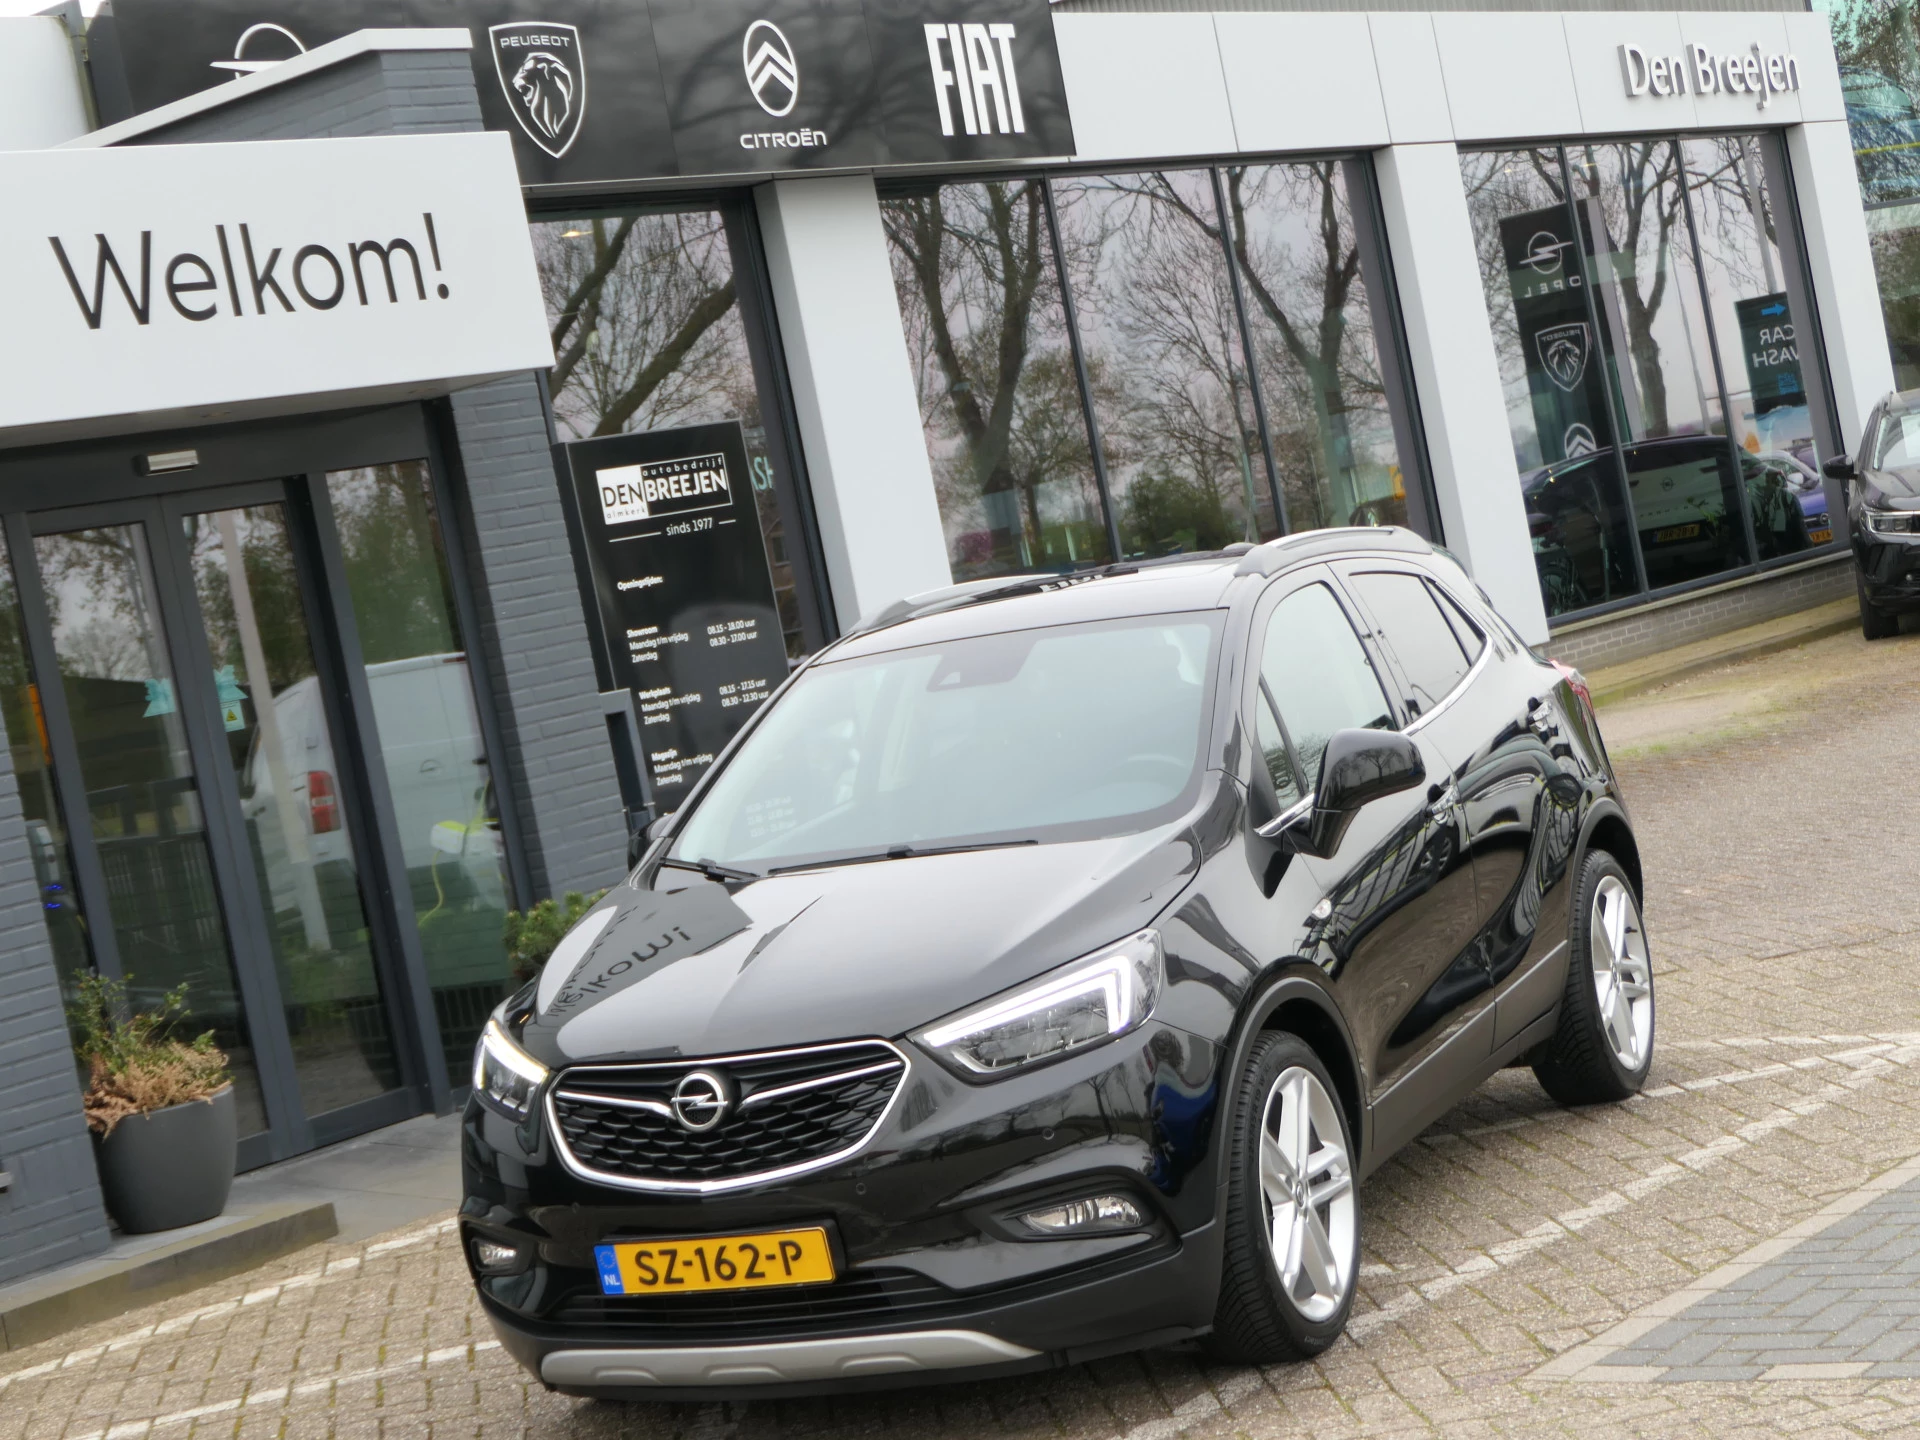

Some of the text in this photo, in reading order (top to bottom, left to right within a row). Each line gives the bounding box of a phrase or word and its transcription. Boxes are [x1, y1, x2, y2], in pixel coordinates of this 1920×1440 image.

[500, 34, 570, 49] PEUGEOT
[924, 23, 1025, 136] FIAT
[1617, 40, 1801, 110] Den Breejen
[48, 212, 450, 330] Welkom!
[643, 457, 722, 476] autobedrijf
[602, 469, 727, 508] DEN BREEJEN
[607, 508, 646, 519] almkerk
[666, 517, 713, 536] sinds 1977
[626, 626, 658, 638] Showroom
[629, 639, 657, 651] Maandag
[668, 632, 689, 643] vrijdag
[631, 651, 658, 663] Zaterdag
[643, 713, 670, 725] Zaterdag
[656, 773, 682, 786] Zaterdag
[604, 1240, 802, 1287] NL SZ-162-P
